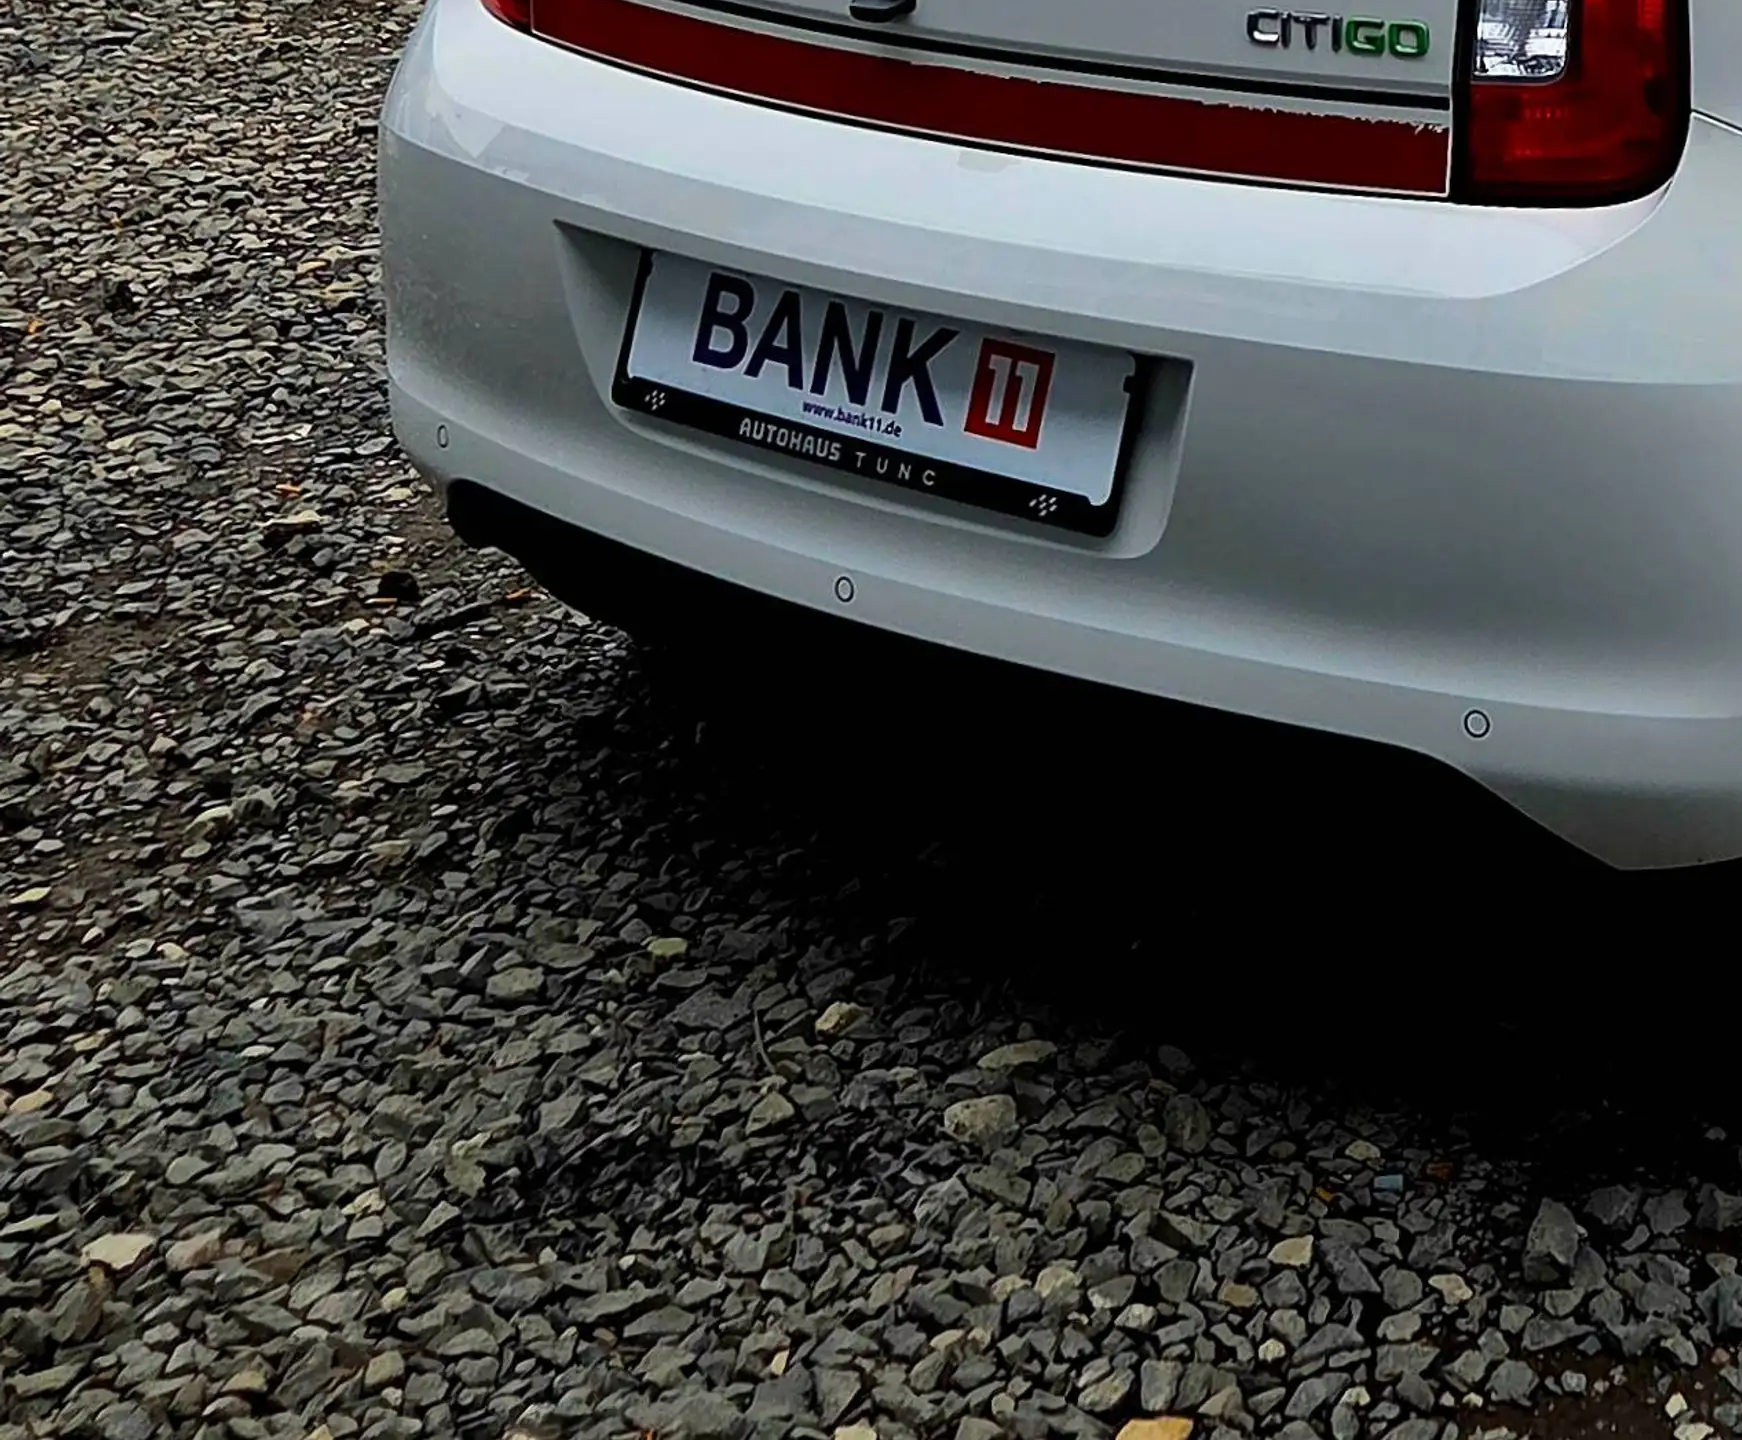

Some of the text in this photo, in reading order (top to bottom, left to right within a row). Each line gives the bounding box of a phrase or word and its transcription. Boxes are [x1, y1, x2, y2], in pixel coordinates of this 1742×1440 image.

[1246, 6, 1431, 58] CITIGO
[692, 271, 960, 428] BANK
[802, 400, 903, 438] www.bank11.de
[739, 417, 937, 487] AUTOHAUS TUNC
